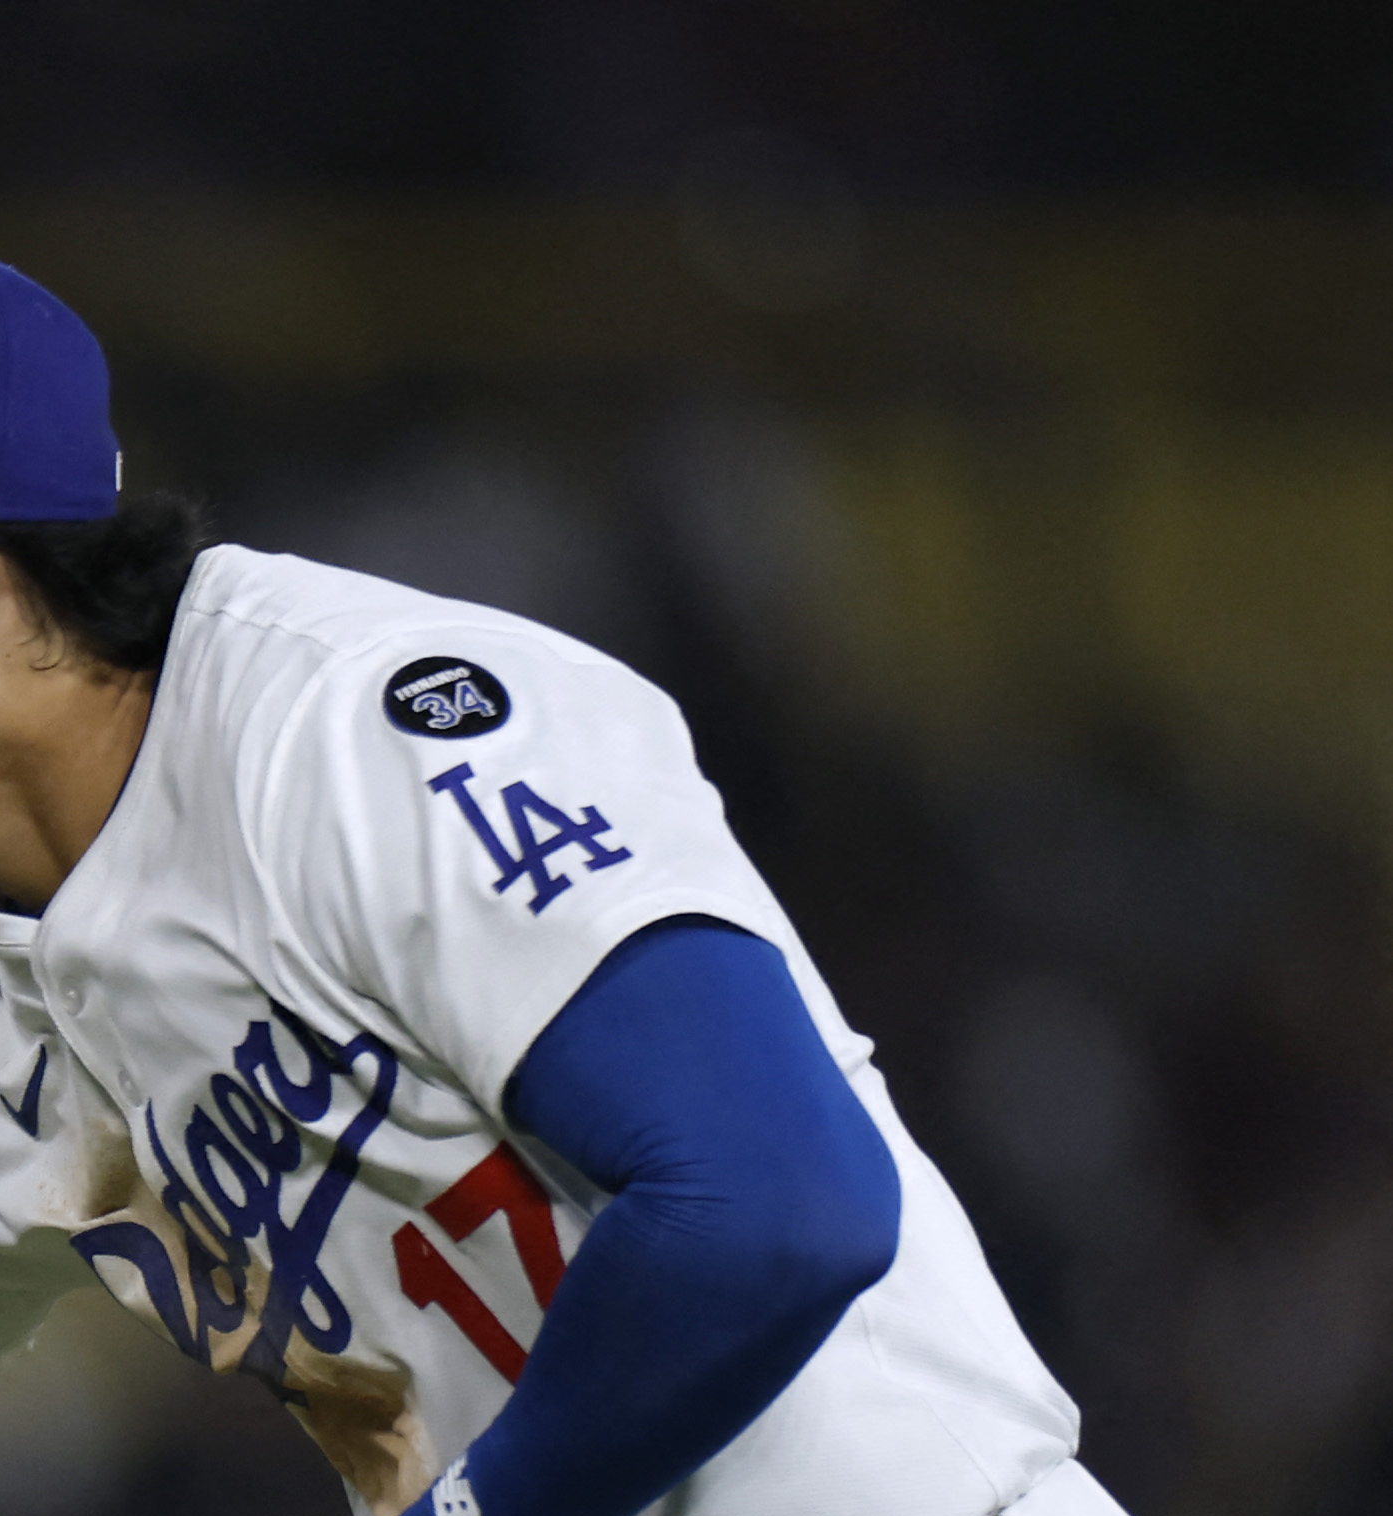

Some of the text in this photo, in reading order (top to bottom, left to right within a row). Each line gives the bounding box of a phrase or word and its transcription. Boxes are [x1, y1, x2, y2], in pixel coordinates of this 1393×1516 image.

[411, 680, 497, 729] 34
[426, 761, 634, 917] LA
[391, 1140, 568, 1388] 17
